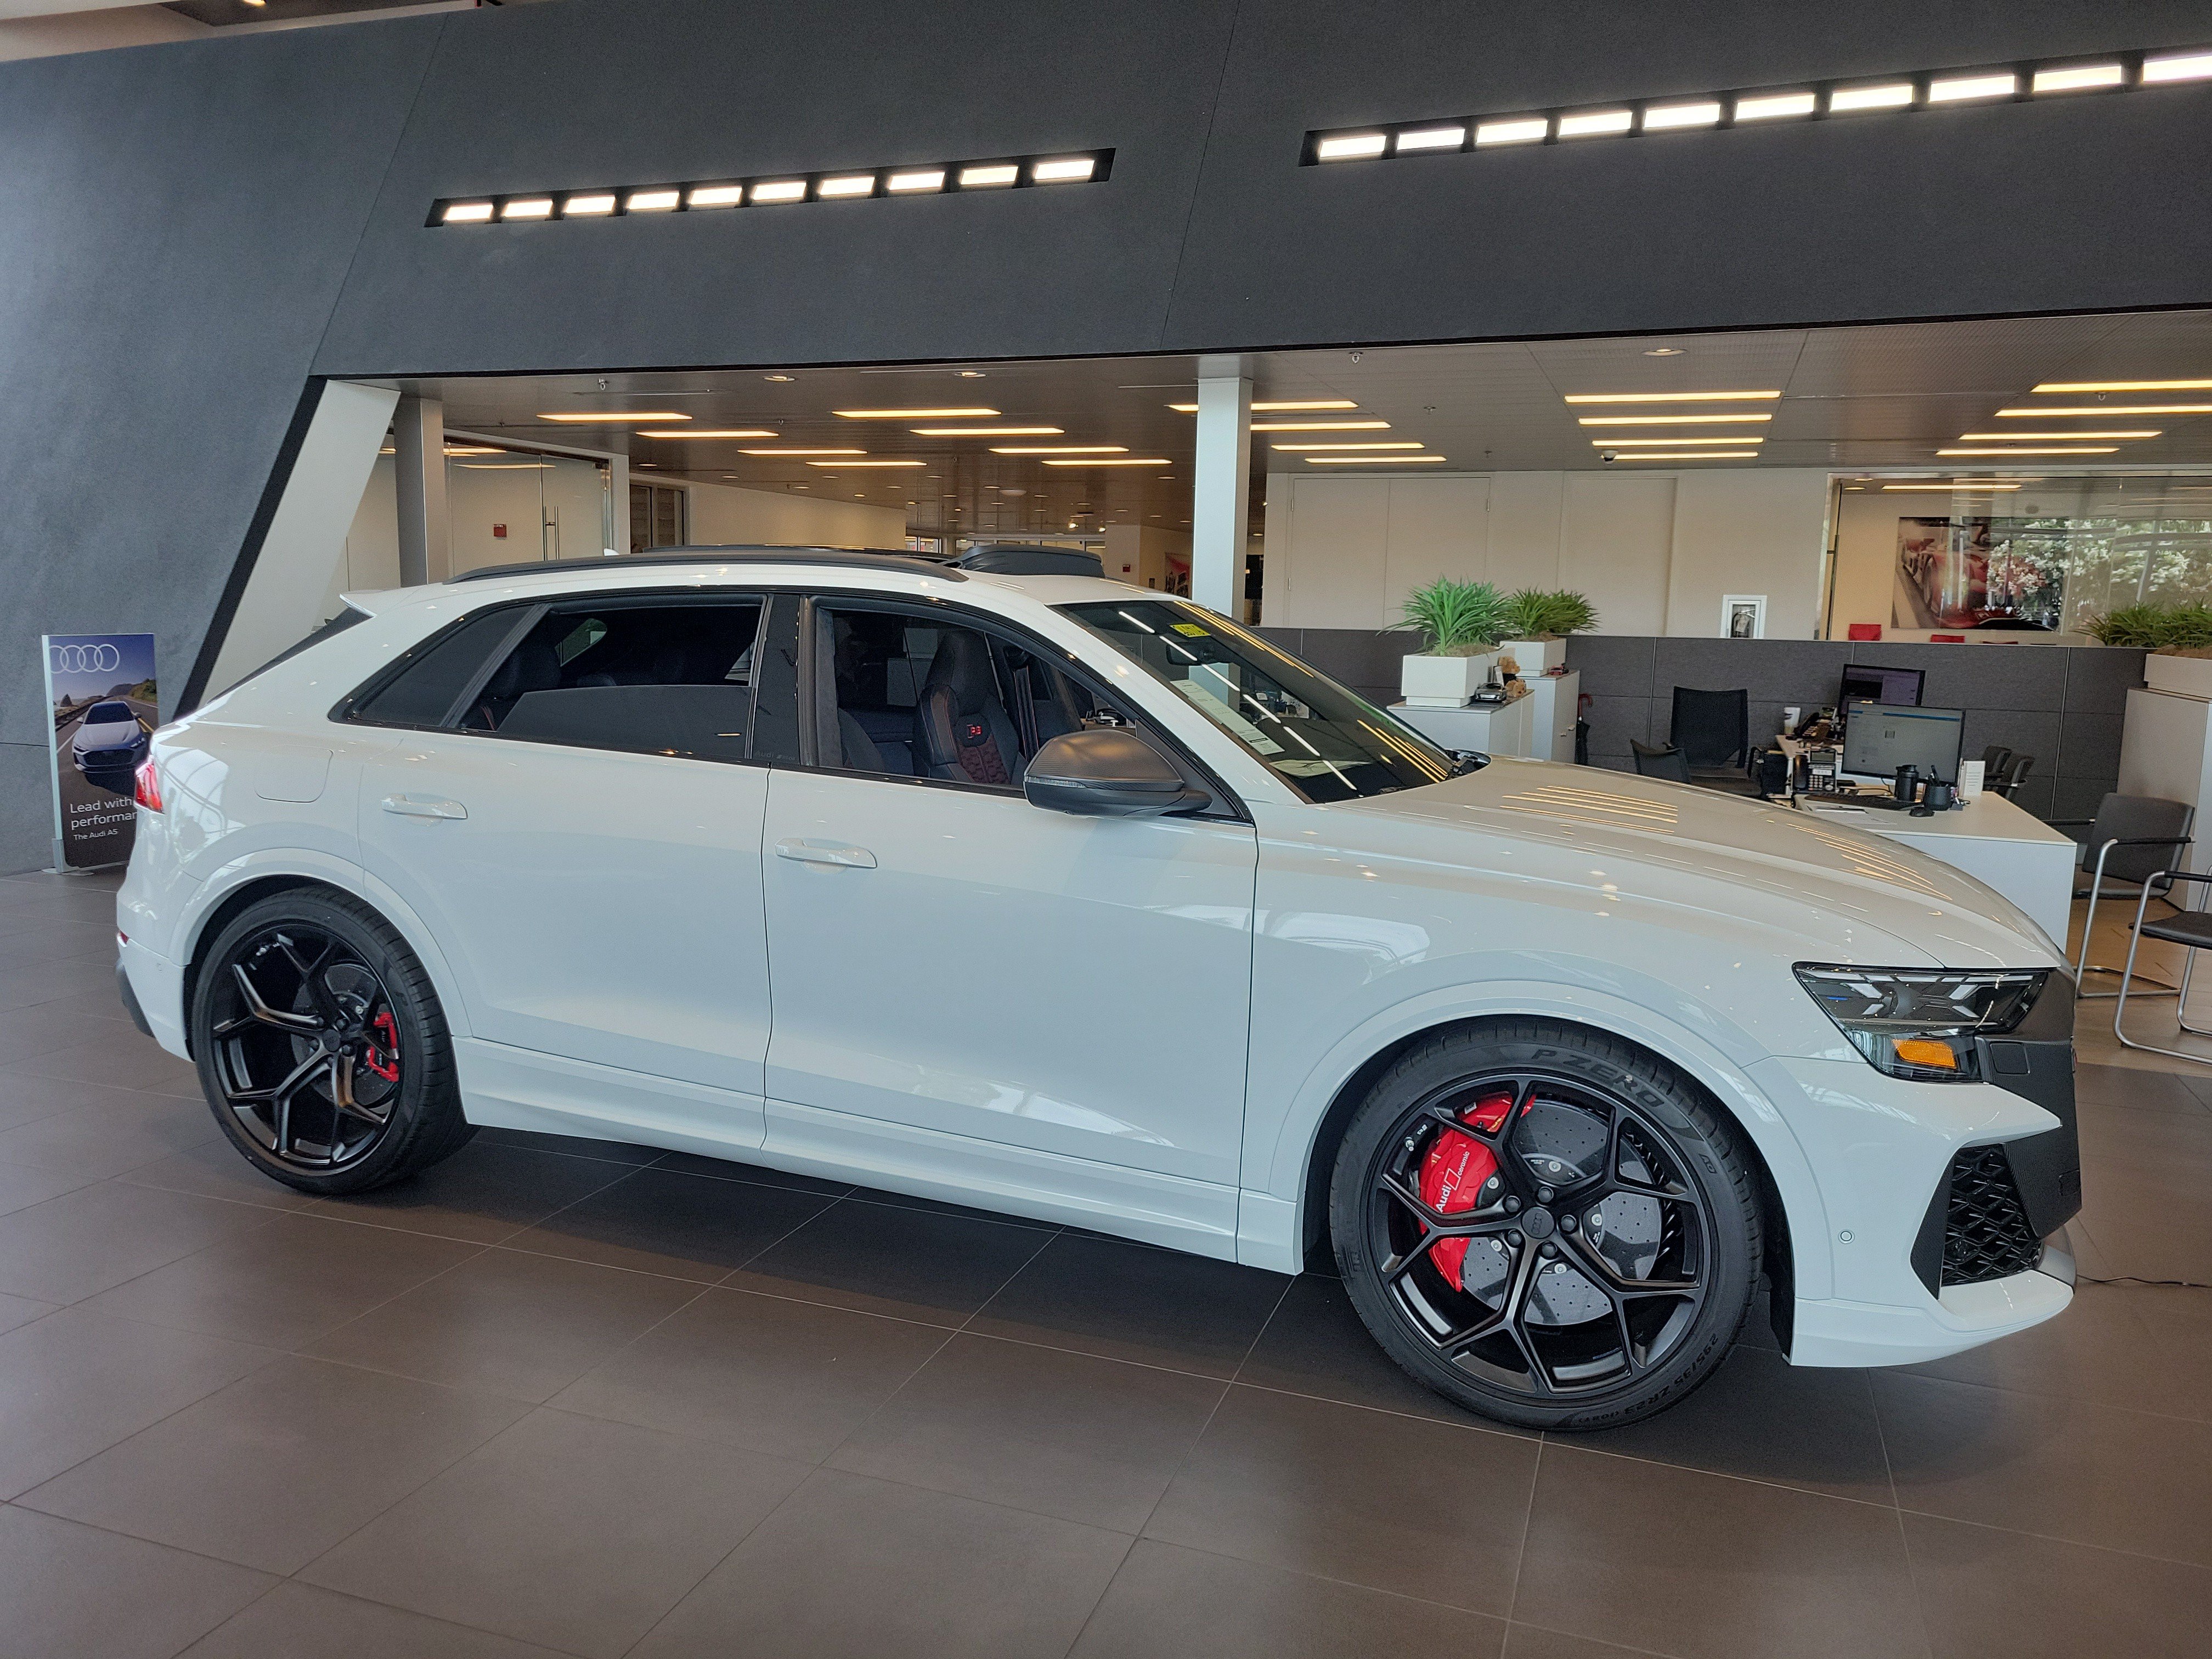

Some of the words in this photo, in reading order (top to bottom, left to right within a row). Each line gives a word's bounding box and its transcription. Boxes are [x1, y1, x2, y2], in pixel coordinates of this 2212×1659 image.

[70, 800, 101, 813] Lead
[104, 797, 132, 809] with
[71, 812, 137, 831] performan
[1531, 1049, 1557, 1060] P
[1563, 1054, 1664, 1108] ZERO
[1436, 1184, 1452, 1213] Audi
[1458, 1151, 1470, 1176] ceramic
[1674, 1333, 1719, 1385] 295/35
[1624, 1385, 1670, 1414] ZR23
